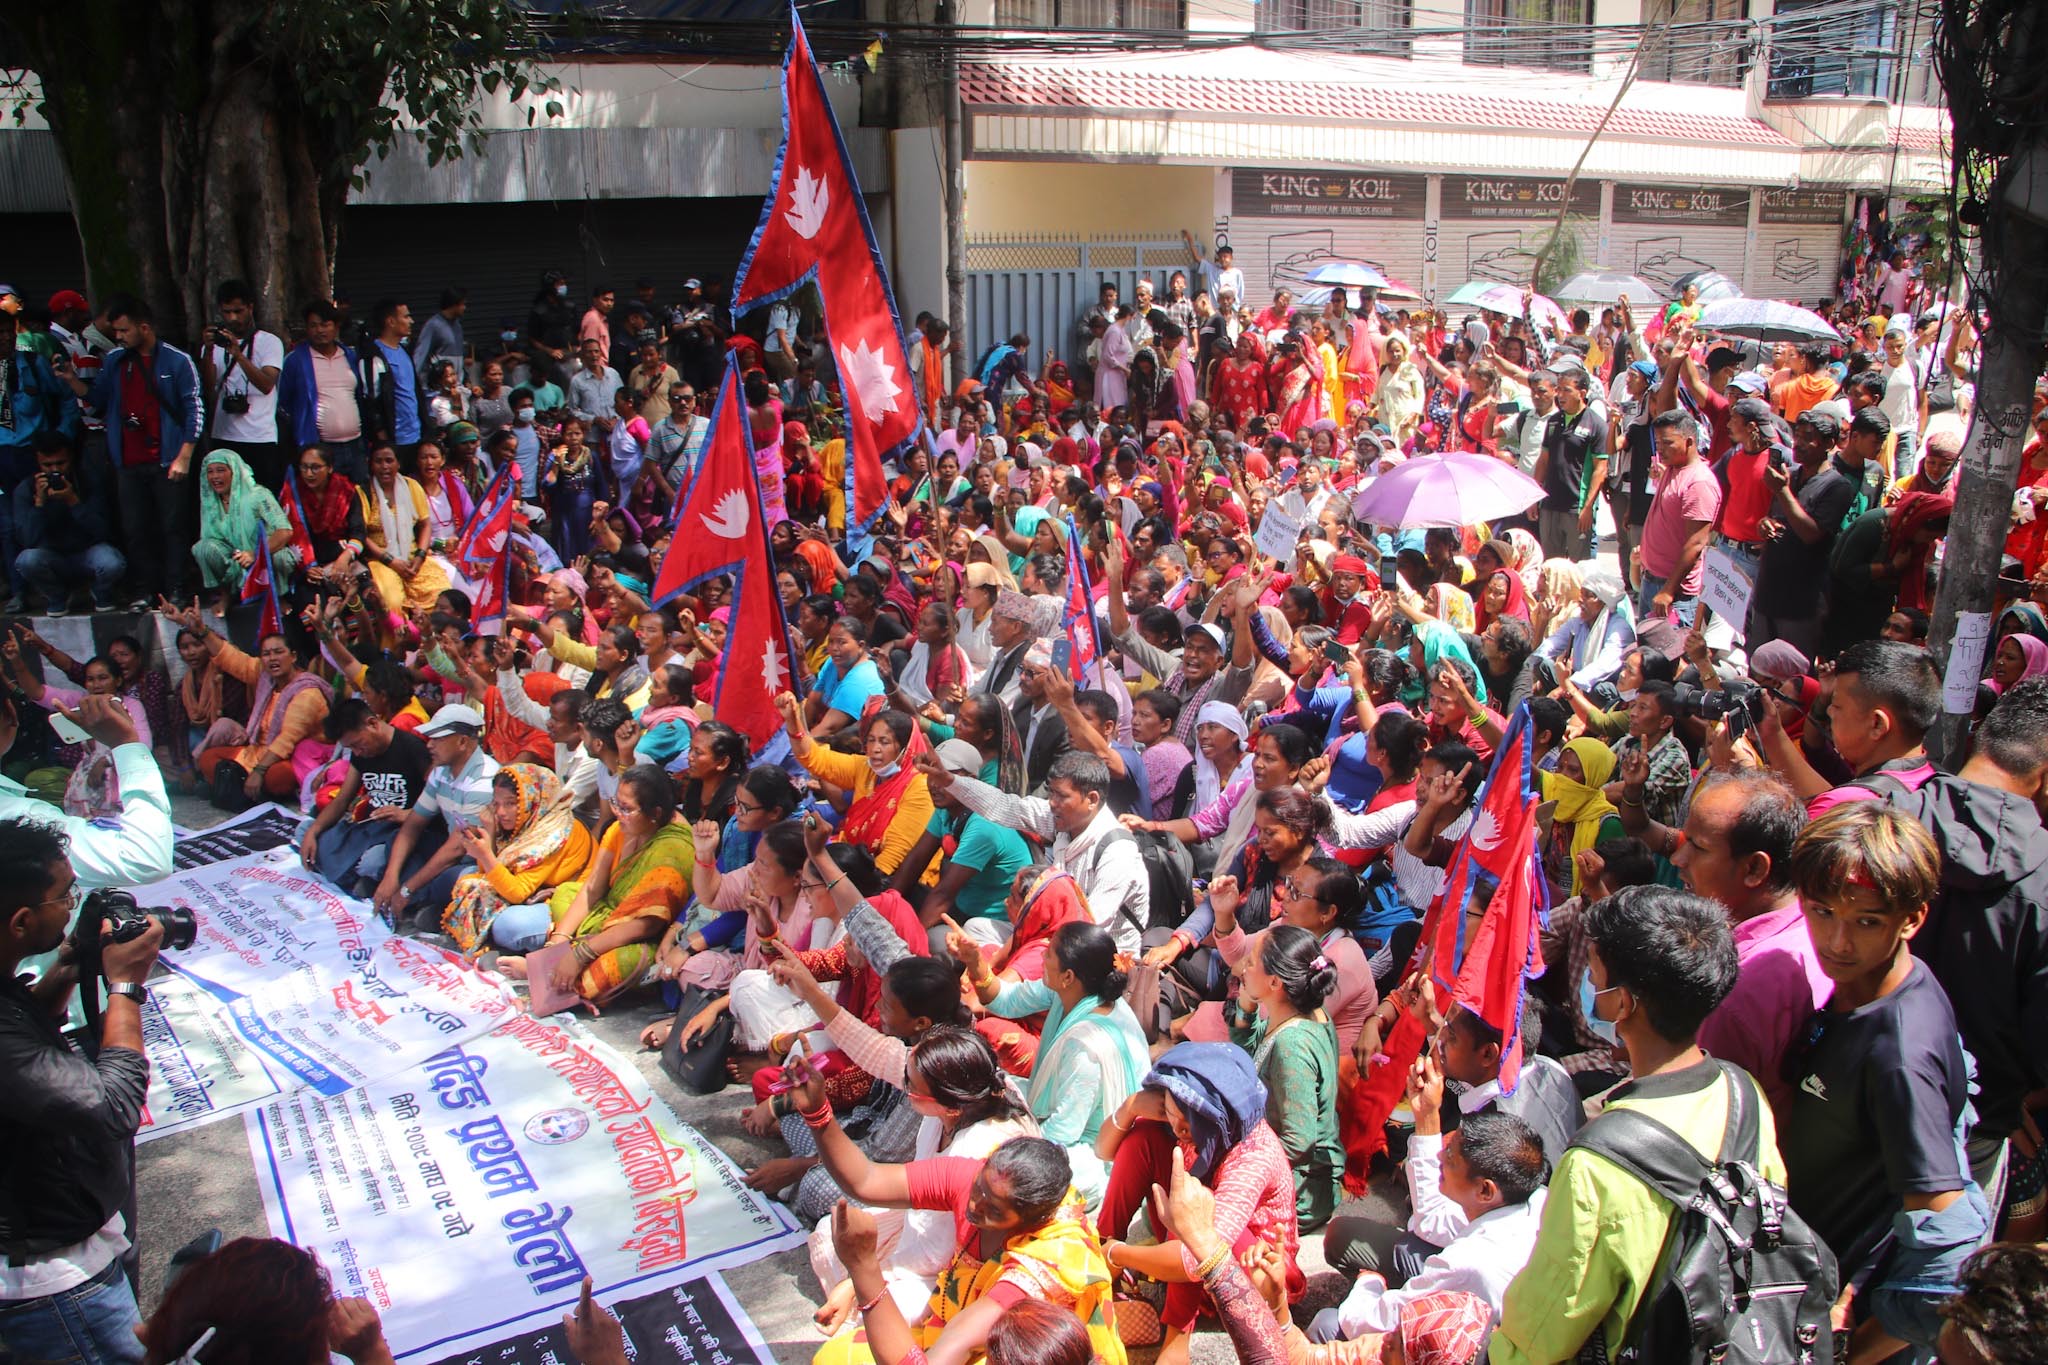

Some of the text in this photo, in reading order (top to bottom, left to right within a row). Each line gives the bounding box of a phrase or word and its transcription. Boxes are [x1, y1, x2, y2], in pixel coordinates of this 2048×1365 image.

[1262, 174, 1395, 200] KING KOIL
[1465, 181, 1513, 201] KING
[1630, 190, 1723, 211] KING KOIL
[1761, 191, 1796, 207] KING
[1215, 216, 1229, 252] OIL
[1425, 220, 1438, 263] KOIL
[415, 1159, 446, 1188] माघ
[440, 1212, 473, 1239] गते
[443, 1114, 539, 1199] प्रथम
[499, 1200, 592, 1295] भेला
